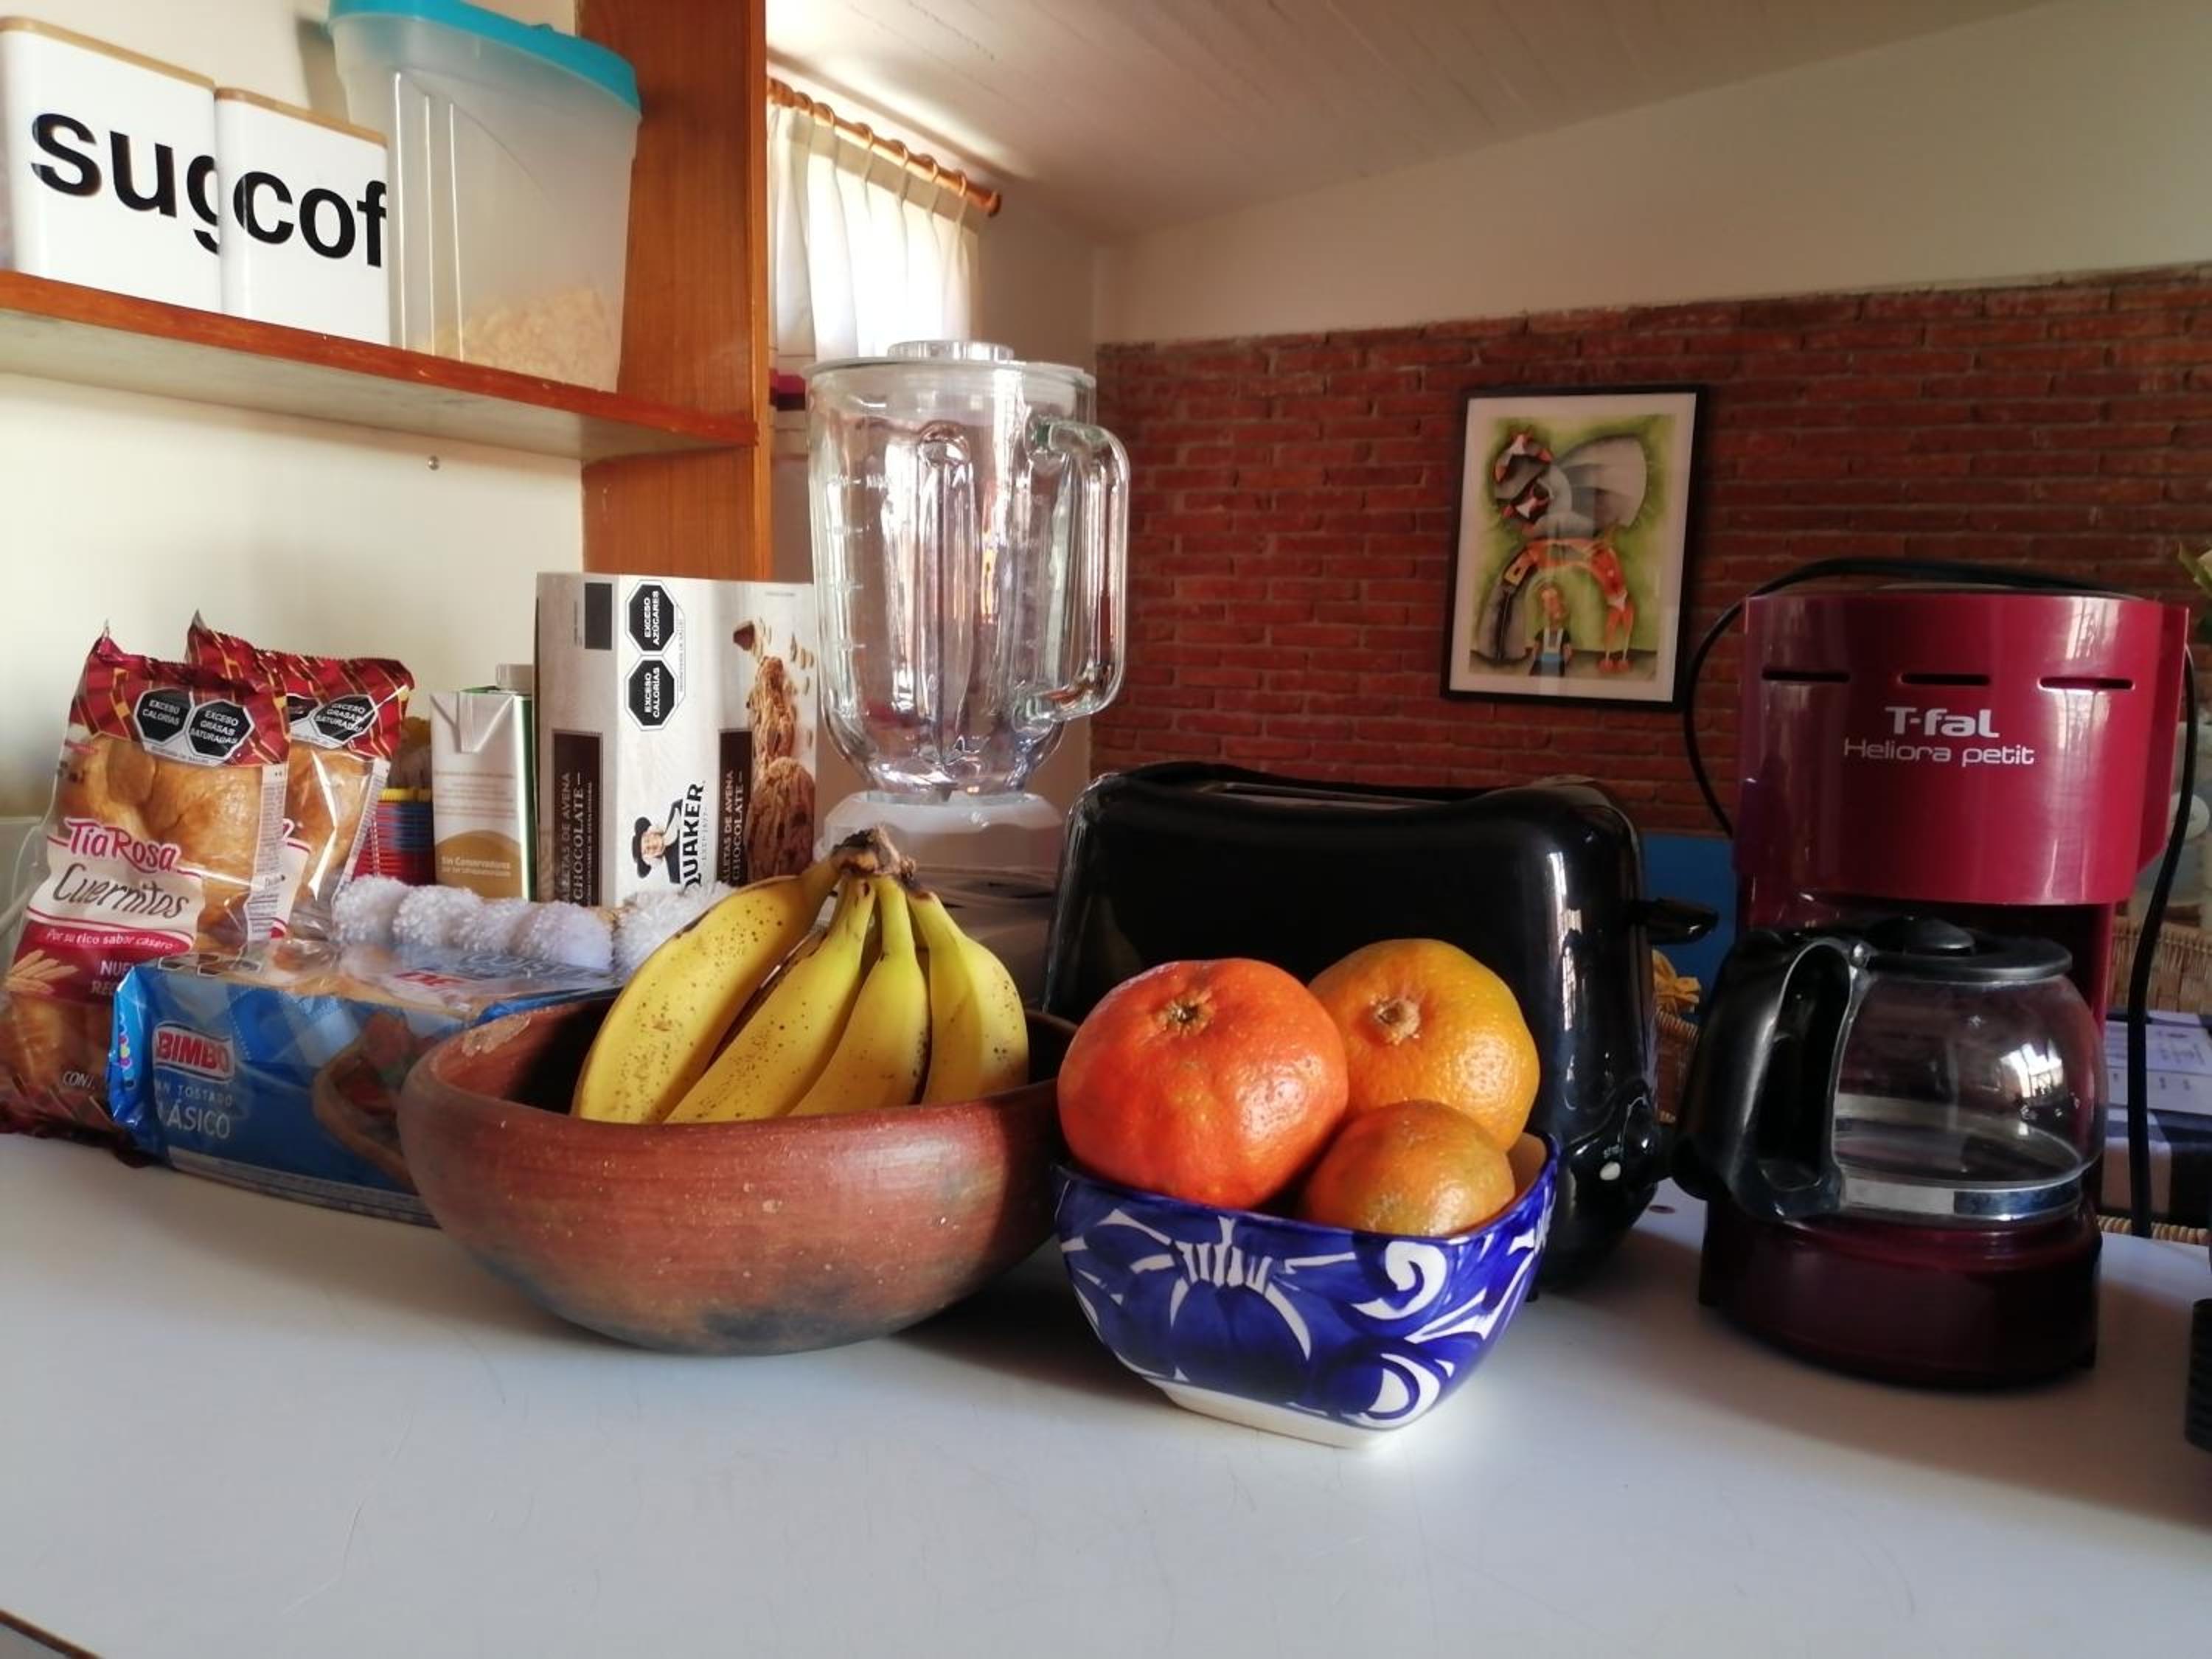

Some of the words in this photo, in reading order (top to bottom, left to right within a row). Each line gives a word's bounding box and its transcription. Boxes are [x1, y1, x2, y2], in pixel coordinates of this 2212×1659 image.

[232, 171, 386, 268] cof
[644, 597, 652, 638] EXCESO
[148, 699, 181, 714] EXCESO
[644, 672, 653, 713] EXCESO
[200, 720, 236, 737] GRASAS
[205, 710, 239, 726] EXCESO
[1885, 706, 2000, 738] T-fal
[1844, 738, 1952, 762] Heliora
[1961, 744, 2035, 768] petit
[562, 772, 571, 819] AVENA
[724, 770, 734, 813] AVENA
[562, 824, 571, 842] DE
[573, 787, 583, 900] CHOCOLATE
[724, 817, 732, 833] DE
[104, 826, 178, 873] Rosa
[53, 863, 189, 919] Cuernitos
[76, 932, 100, 945] rico
[102, 933, 135, 945] sabor
[135, 936, 174, 950] casero
[156, 1030, 230, 1074] BIMBO
